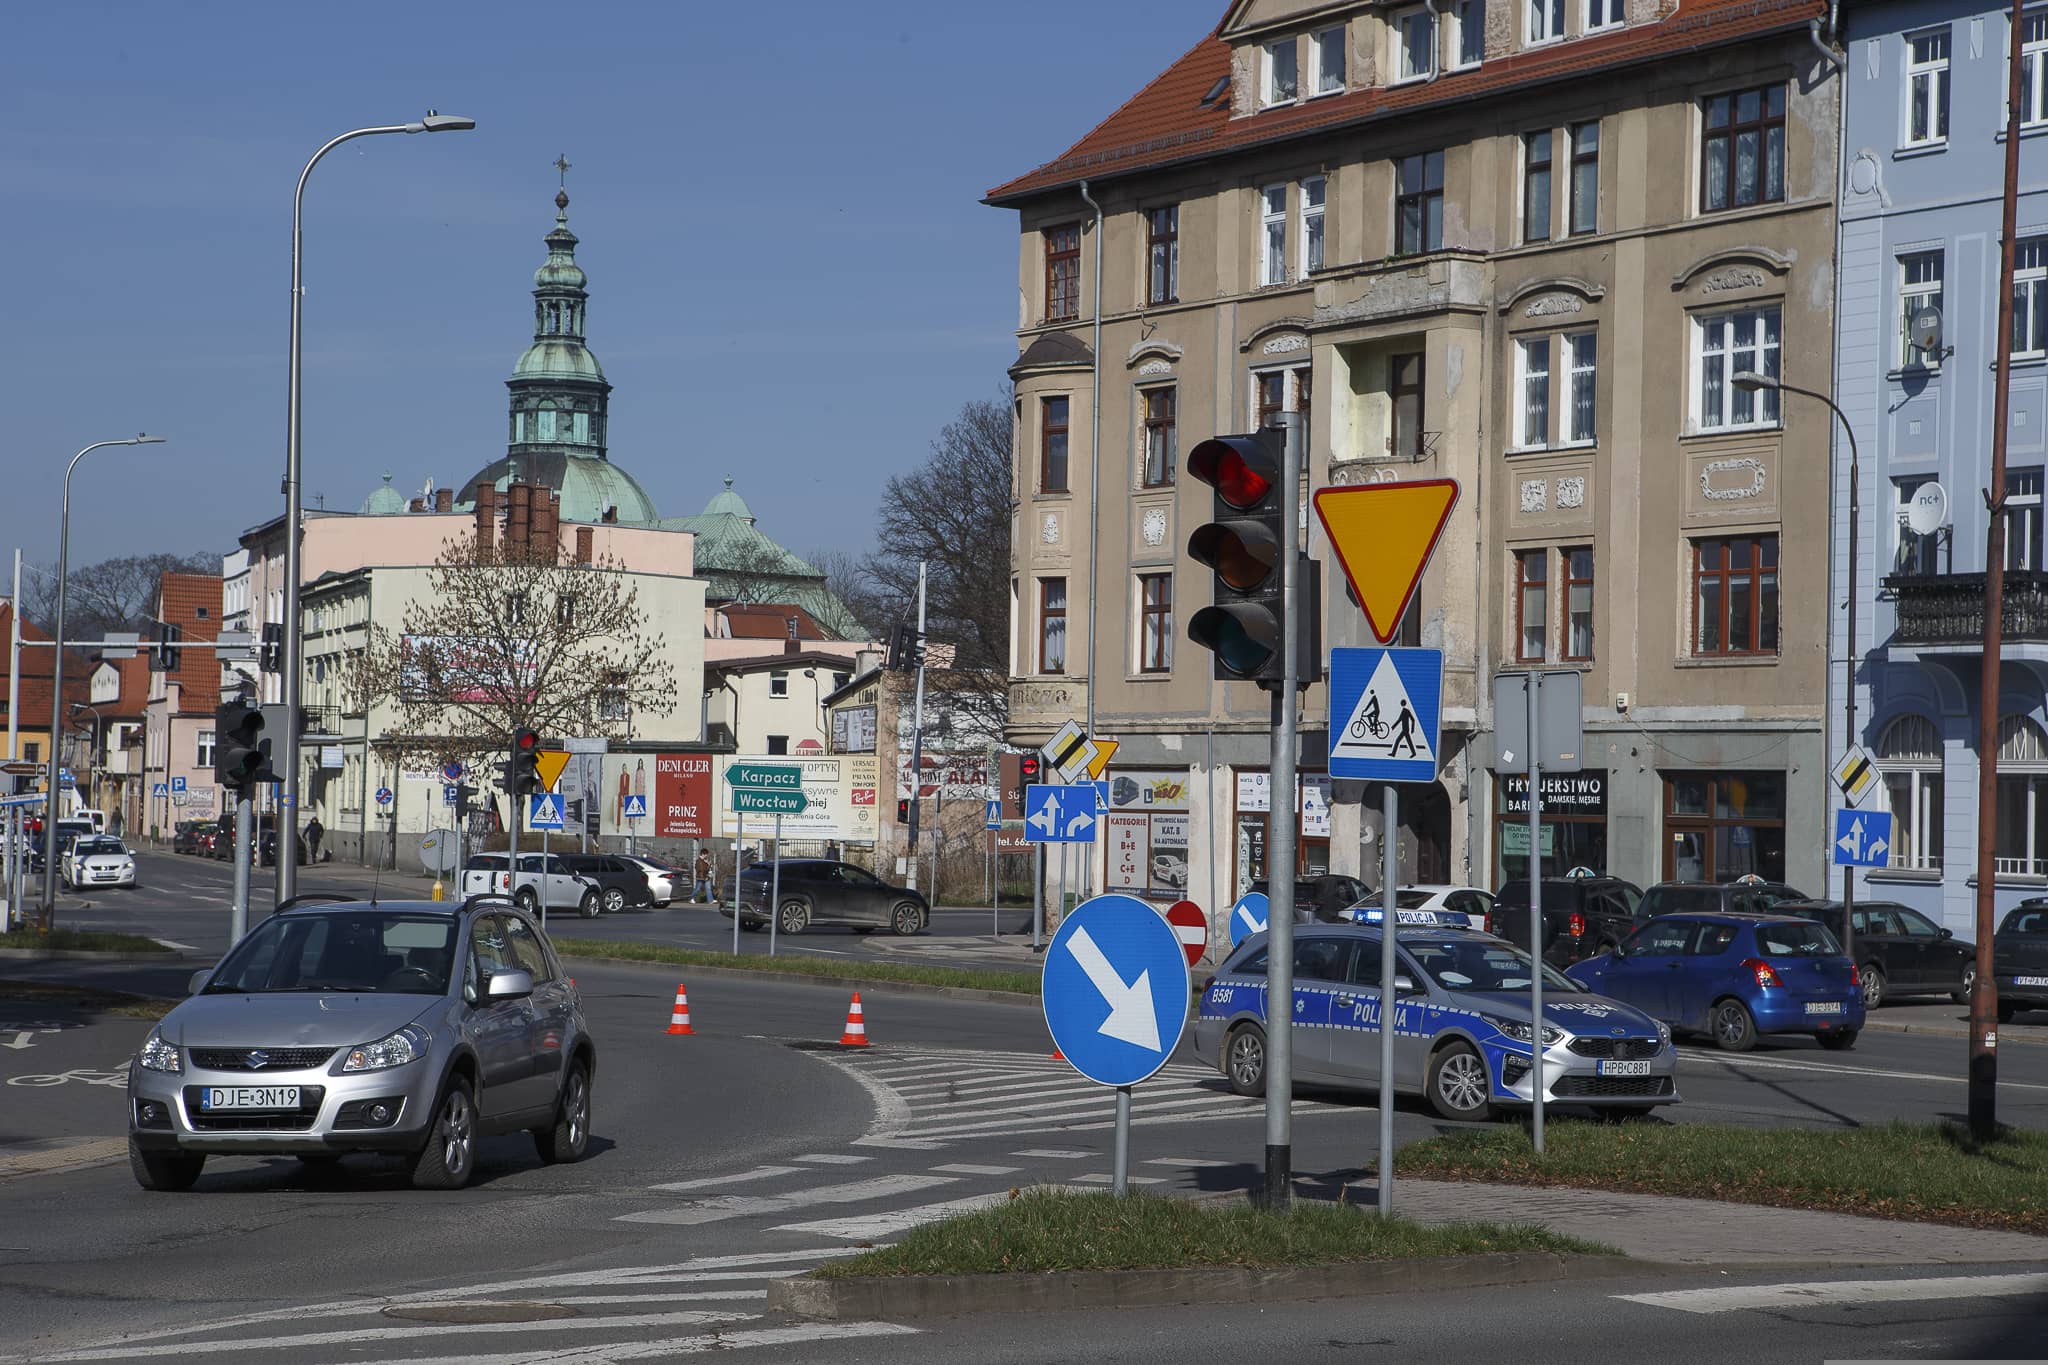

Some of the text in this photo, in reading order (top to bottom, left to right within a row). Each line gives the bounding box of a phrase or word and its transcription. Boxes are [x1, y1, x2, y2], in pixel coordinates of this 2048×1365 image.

[1919, 495, 1939, 505] nc+
[658, 759, 709, 773] DENI CLER
[807, 763, 837, 773] OPTYK
[174, 778, 182, 787] P
[741, 769, 795, 786] Karpacz
[802, 786, 838, 797] esywne
[1508, 779, 1601, 794] FRYJERSTWO
[740, 793, 798, 809] Wrocław
[808, 797, 827, 809] niej
[1508, 800, 1545, 812] BARR
[1548, 795, 1601, 807] DAMSKIE, MĘSKIE
[668, 806, 697, 818] PRINZ
[1110, 817, 1147, 826] KATEGORIE
[1125, 830, 1131, 839] B
[1161, 826, 1175, 835] KAT.
[998, 838, 1012, 846] tel.
[1120, 841, 1136, 850] B+E
[1125, 853, 1131, 862] C
[1120, 864, 1135, 873] C+E
[1124, 876, 1130, 885] D
[1400, 912, 1435, 924] POLICJA
[1212, 988, 1233, 1003] B581
[1353, 1002, 1407, 1028] POLIJA
[1604, 1062, 1648, 1074] HPB C881
[213, 1088, 297, 1106] DJE 3N19
